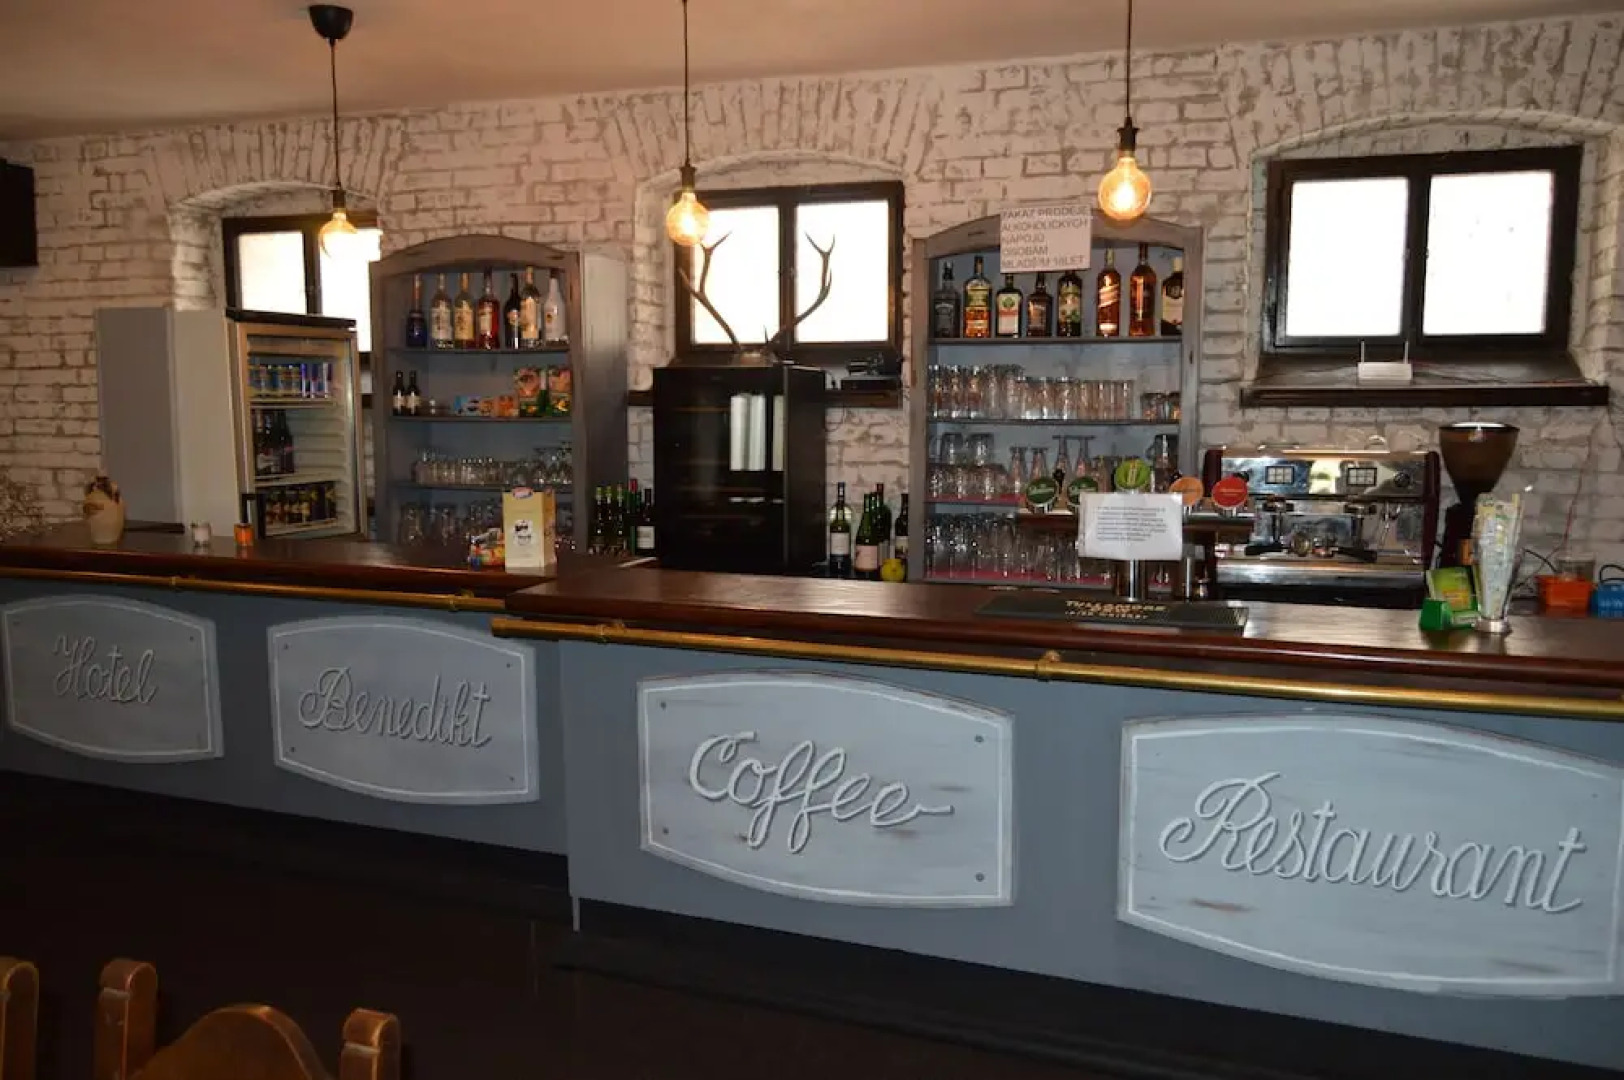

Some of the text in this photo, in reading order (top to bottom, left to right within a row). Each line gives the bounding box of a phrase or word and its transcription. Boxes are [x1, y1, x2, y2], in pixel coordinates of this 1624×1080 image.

[51, 633, 158, 704] Hotel
[299, 667, 493, 749] Benedikt
[689, 730, 955, 854] Coffee
[1158, 772, 1587, 914] Restaurant
